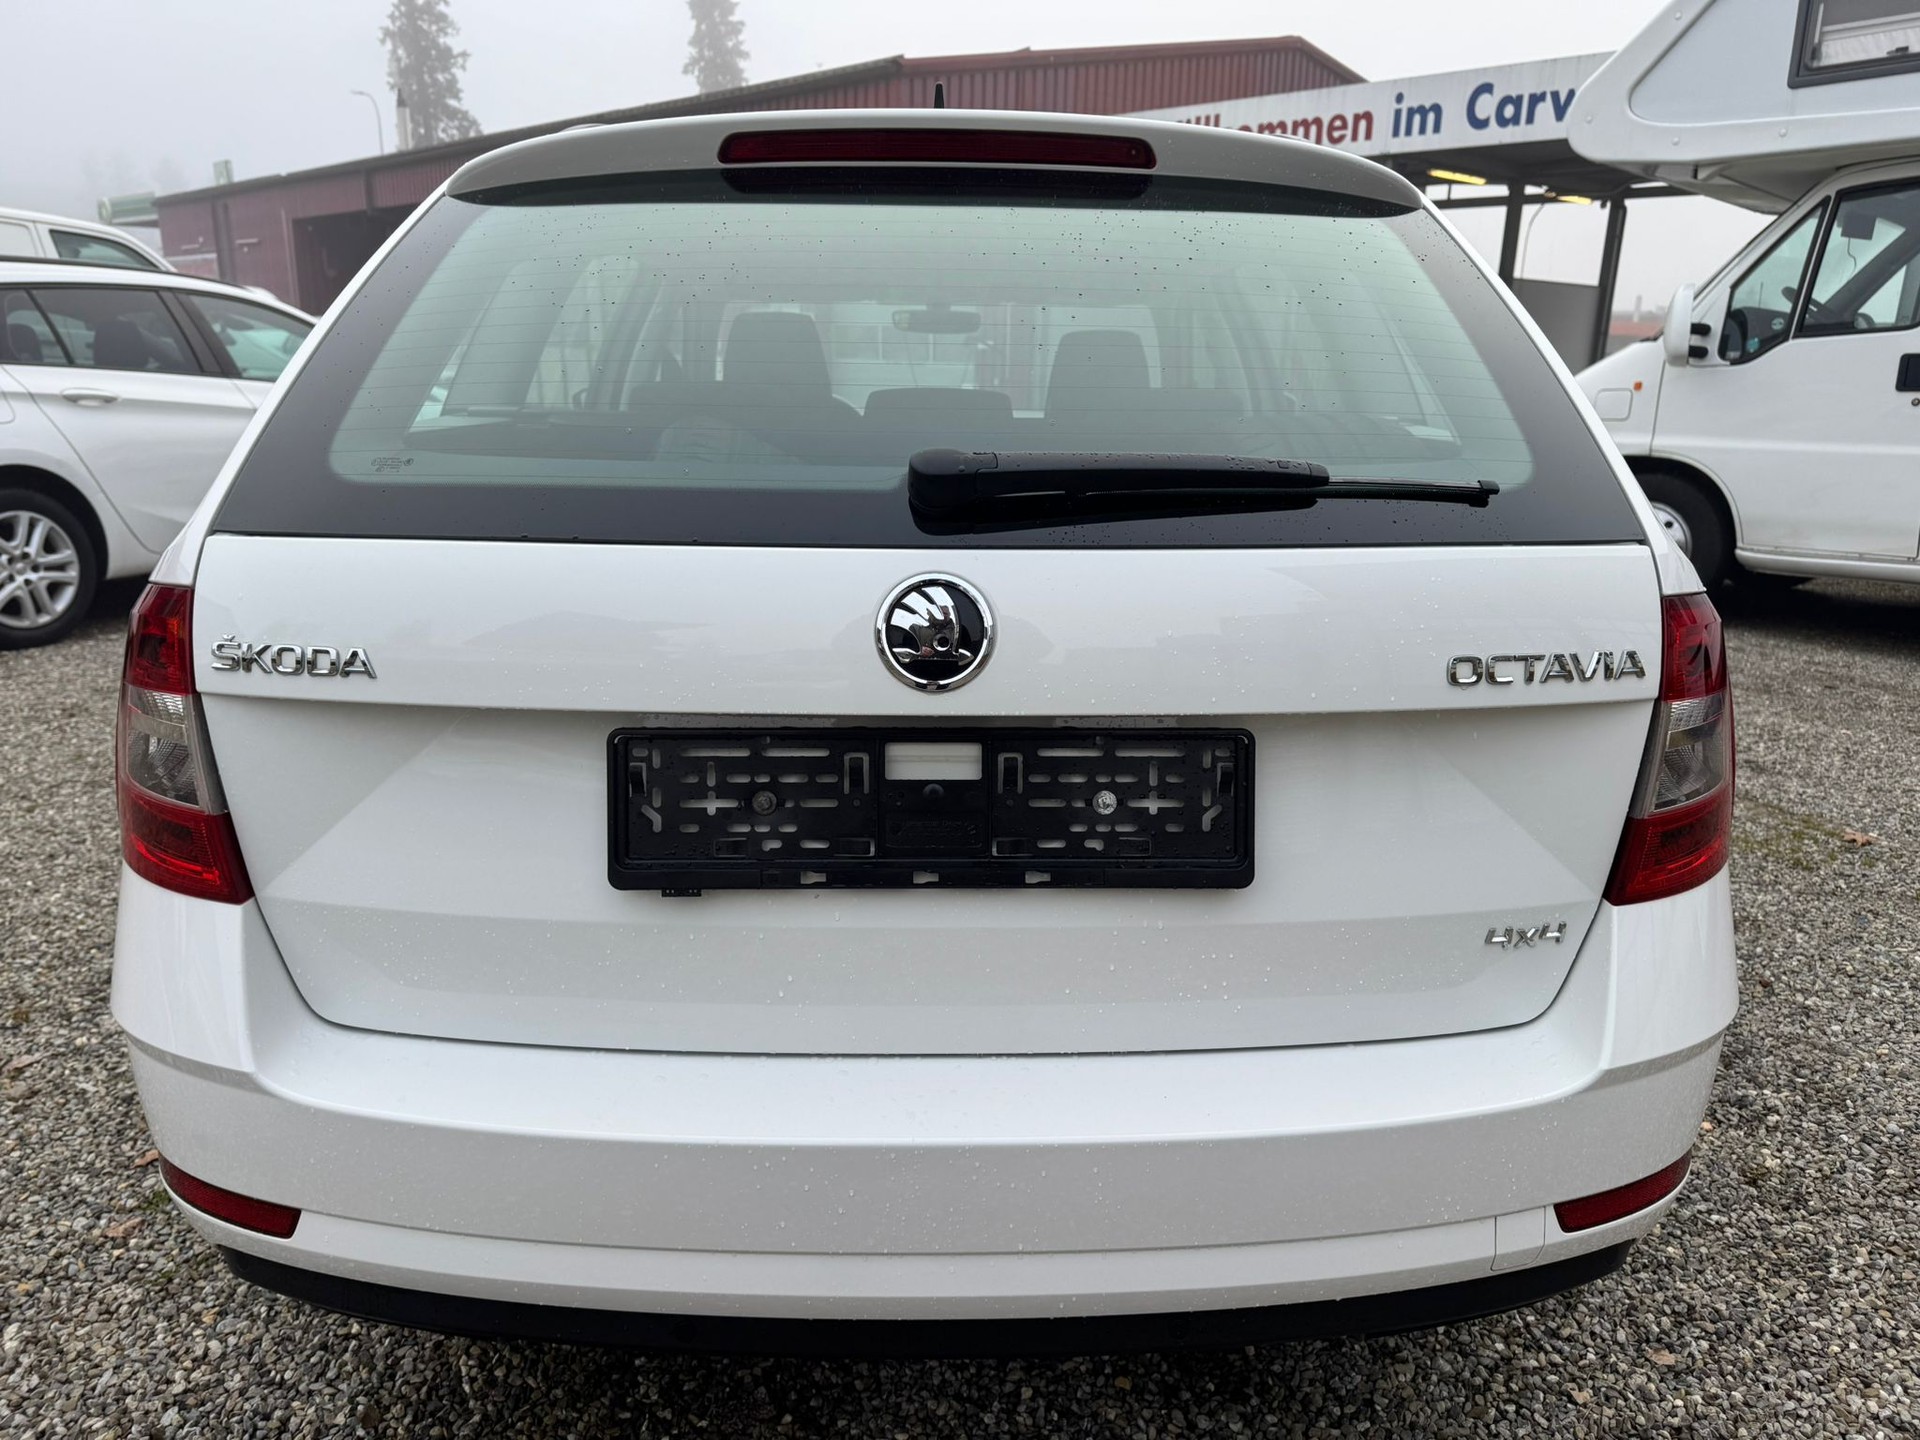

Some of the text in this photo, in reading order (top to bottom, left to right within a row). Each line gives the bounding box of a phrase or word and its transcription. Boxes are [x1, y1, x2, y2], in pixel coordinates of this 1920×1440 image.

[1392, 92, 1443, 138] im
[211, 634, 377, 679] ŠKODA
[1447, 650, 1646, 687] OCTAVIA
